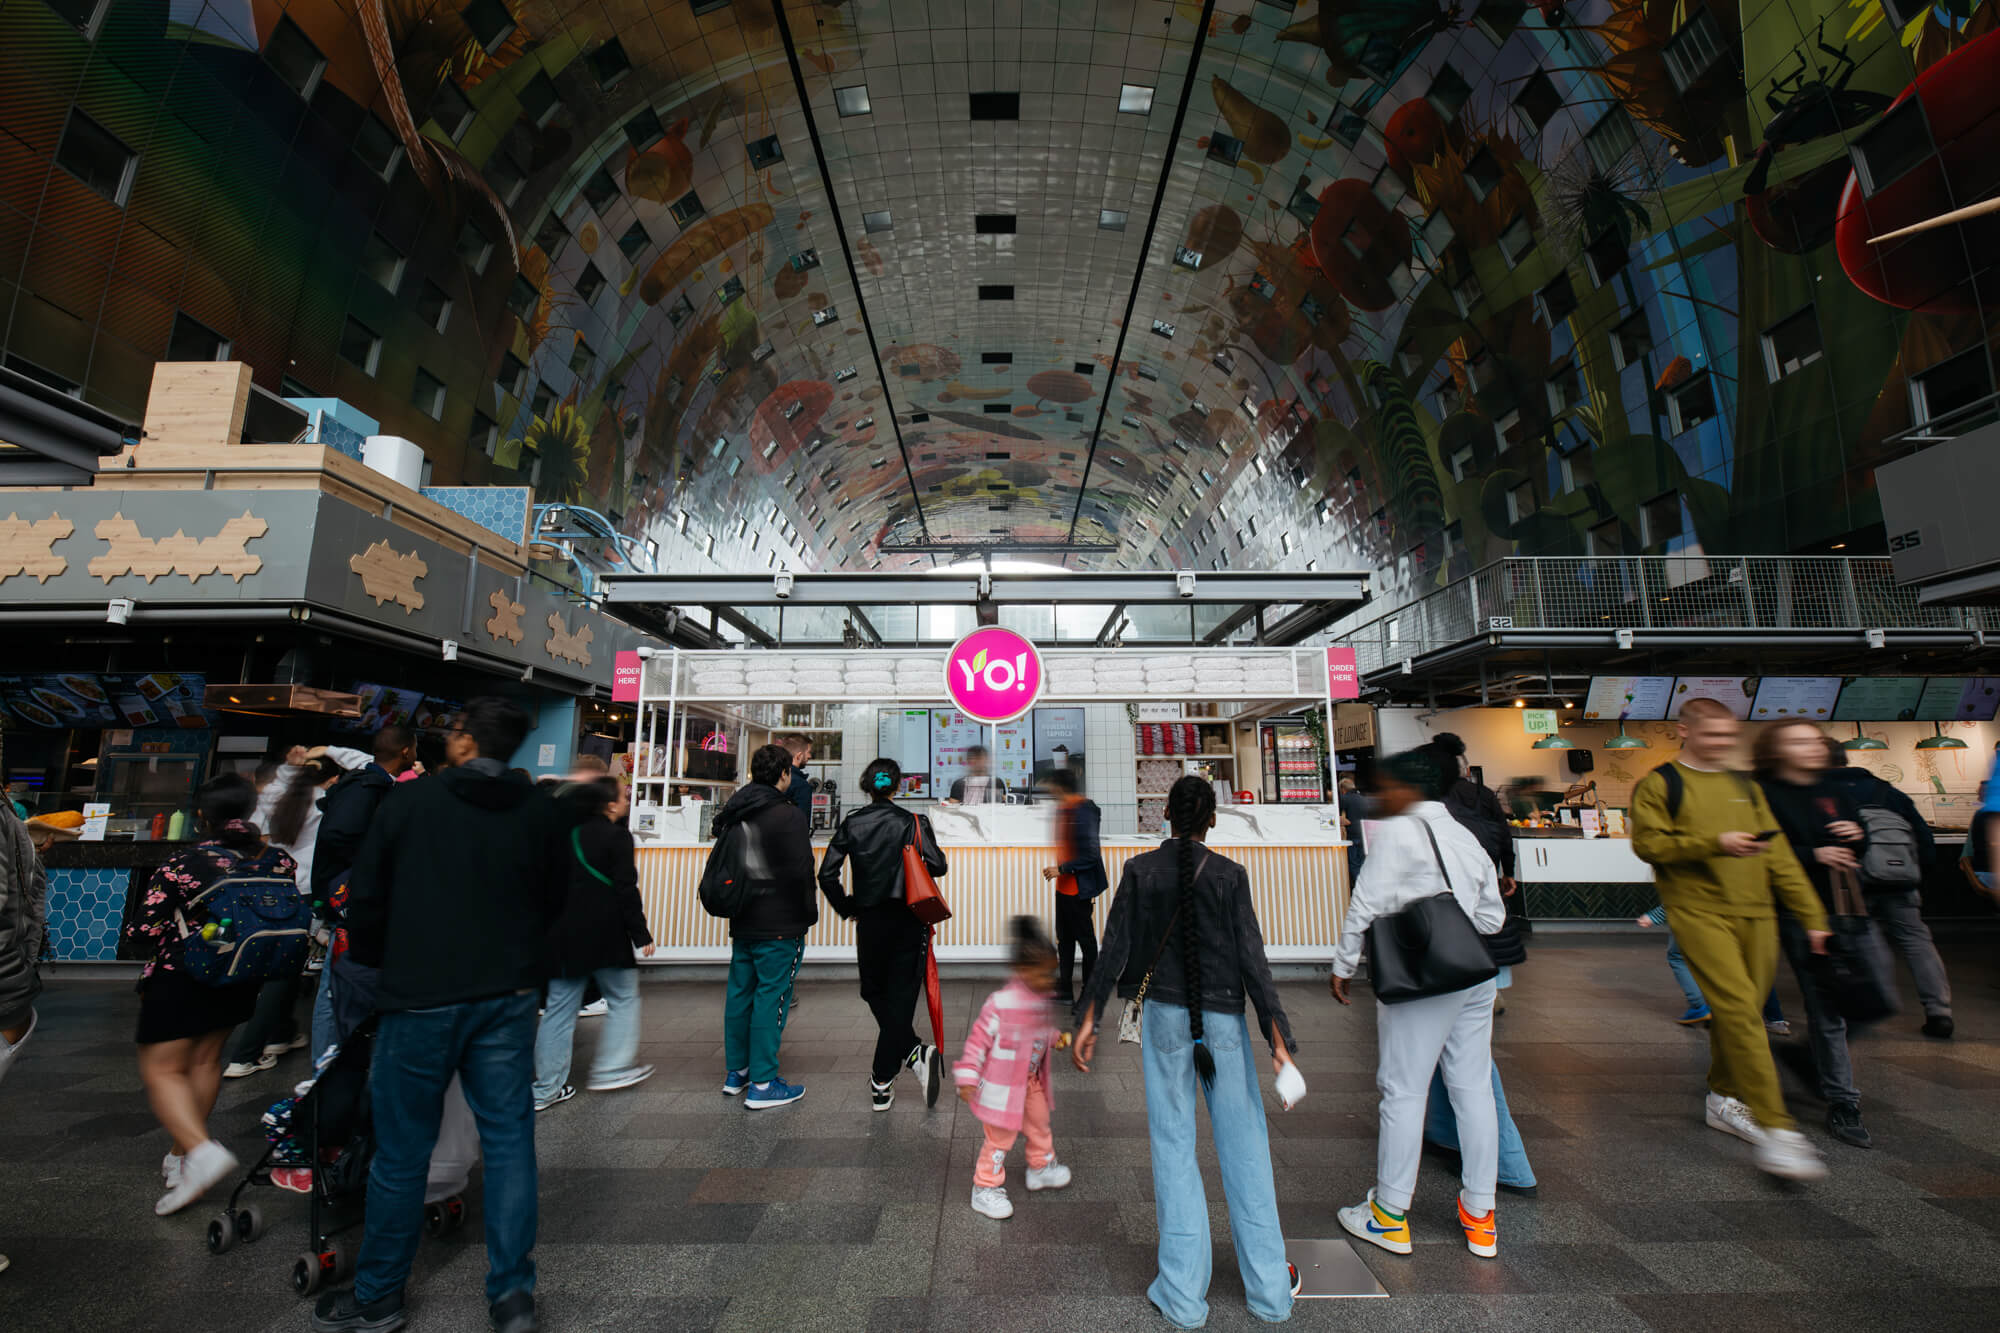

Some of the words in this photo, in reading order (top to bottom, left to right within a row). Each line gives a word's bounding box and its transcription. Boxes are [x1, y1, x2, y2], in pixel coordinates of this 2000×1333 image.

[1890, 529, 1920, 552] 35
[1491, 617, 1512, 628] 32
[616, 667, 640, 675] ORDER
[957, 649, 1027, 692] YO!
[1329, 664, 1354, 672] ORDER
[1333, 673, 1353, 682] HERE
[1528, 720, 1549, 730] UP!
[1344, 721, 1368, 744] LOUNGE
